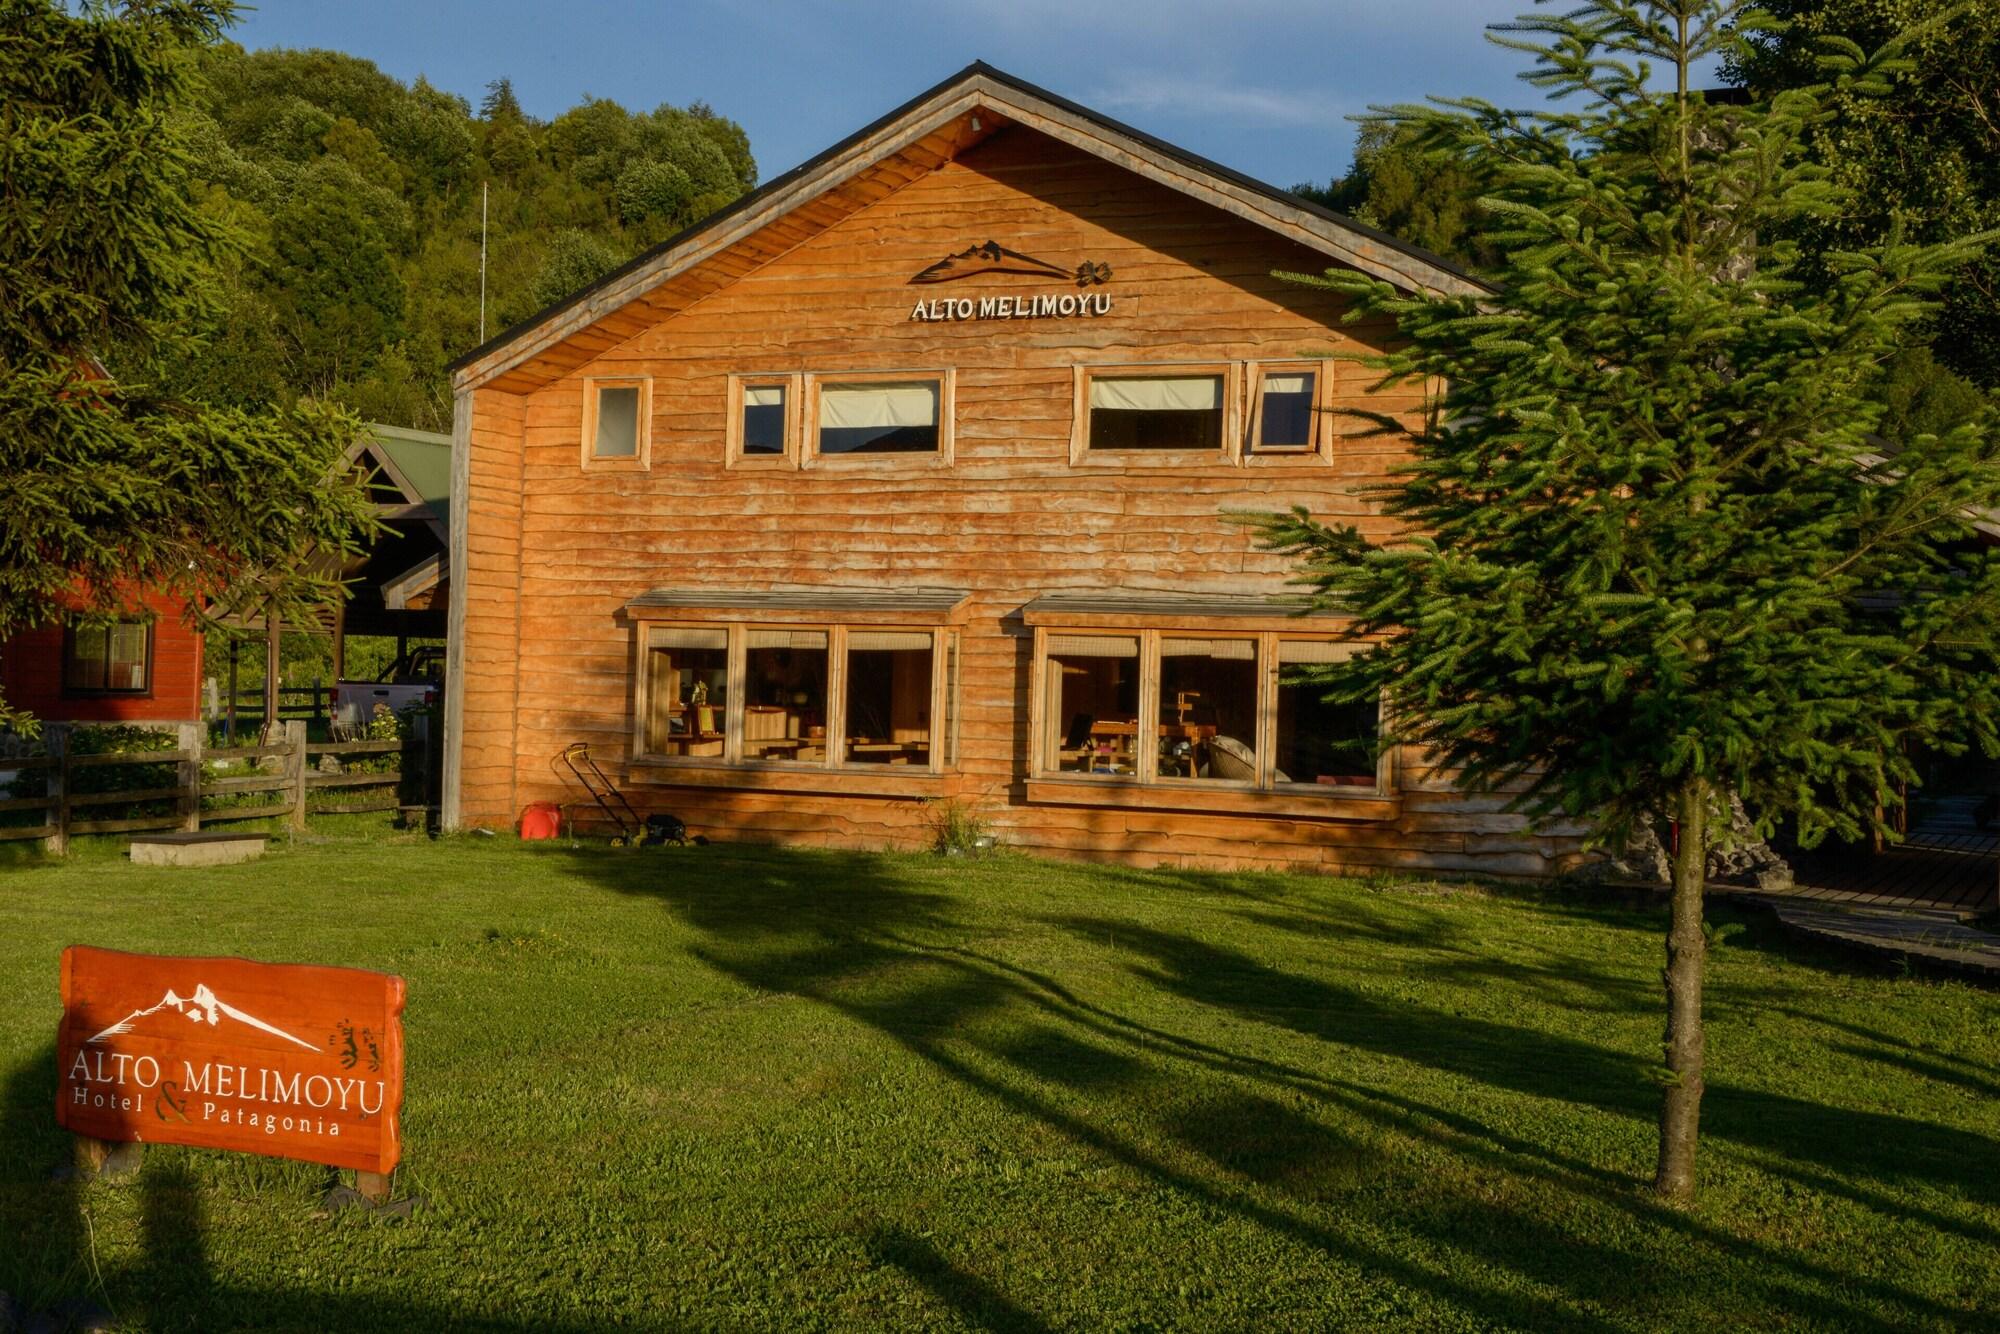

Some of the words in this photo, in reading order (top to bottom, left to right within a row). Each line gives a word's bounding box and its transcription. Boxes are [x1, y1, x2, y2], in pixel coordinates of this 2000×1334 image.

[911, 298, 973, 320] ALTO
[980, 293, 1112, 317] MELIMOYU
[69, 1049, 160, 1089] ALTO
[183, 1060, 385, 1114] MELIMOYU
[73, 1087, 142, 1112] Hotel
[156, 1080, 193, 1125] &
[203, 1102, 340, 1136] Patagonia
